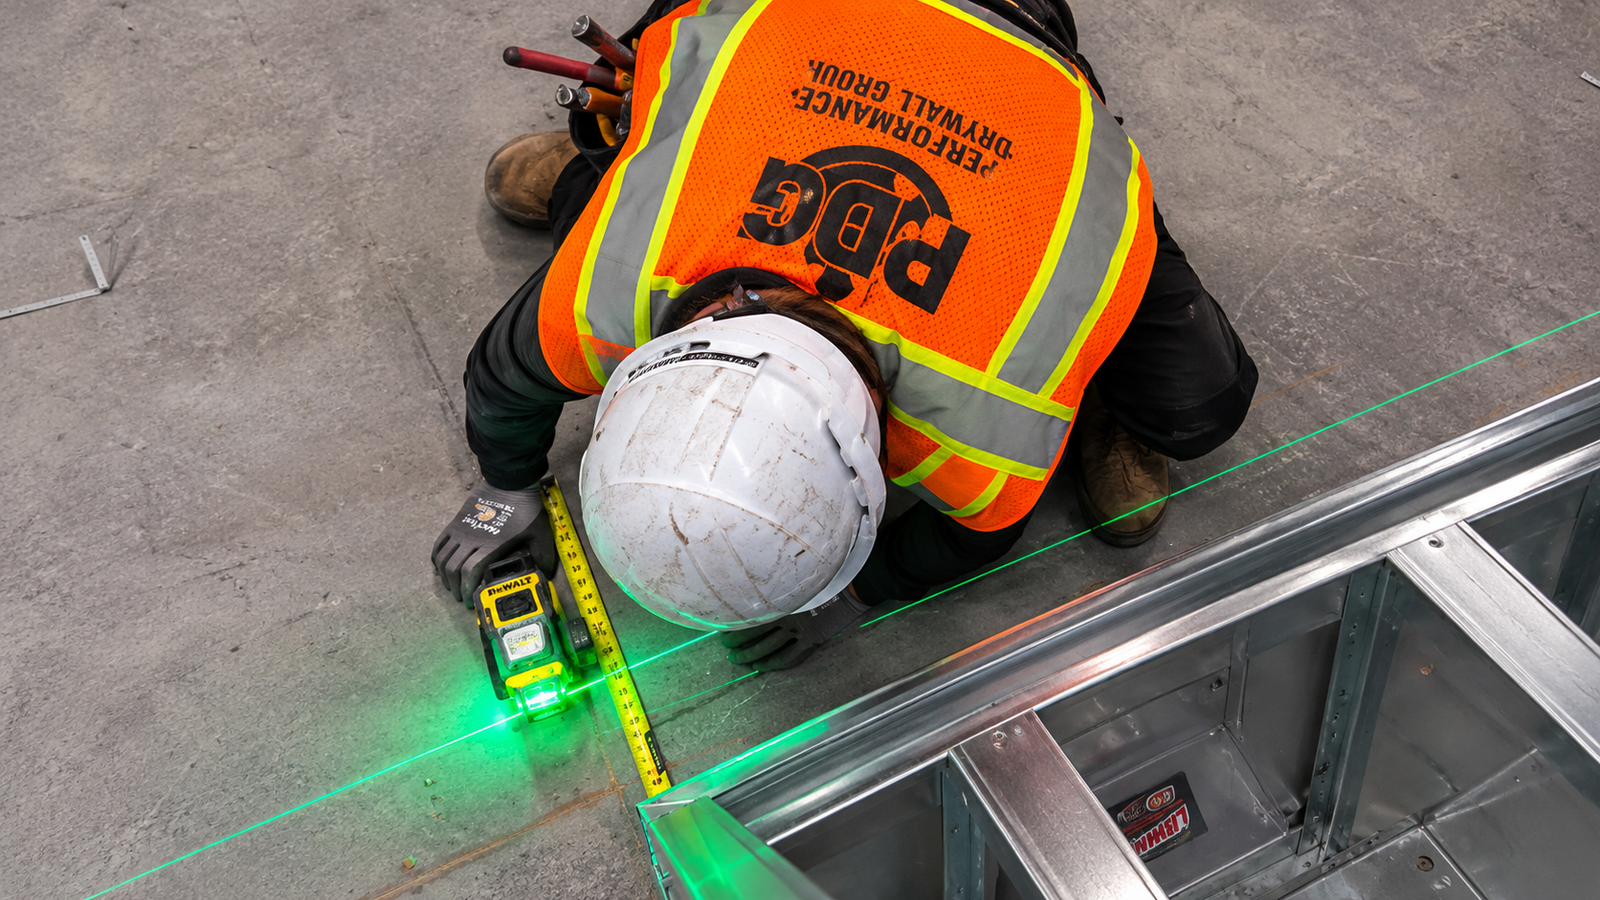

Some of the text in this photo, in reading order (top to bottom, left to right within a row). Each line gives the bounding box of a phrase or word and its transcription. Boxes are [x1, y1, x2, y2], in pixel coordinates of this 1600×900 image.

[794, 86, 999, 180] PERFORMANCE
[901, 89, 1013, 161] DRYWALL
[738, 157, 971, 315] PDG
